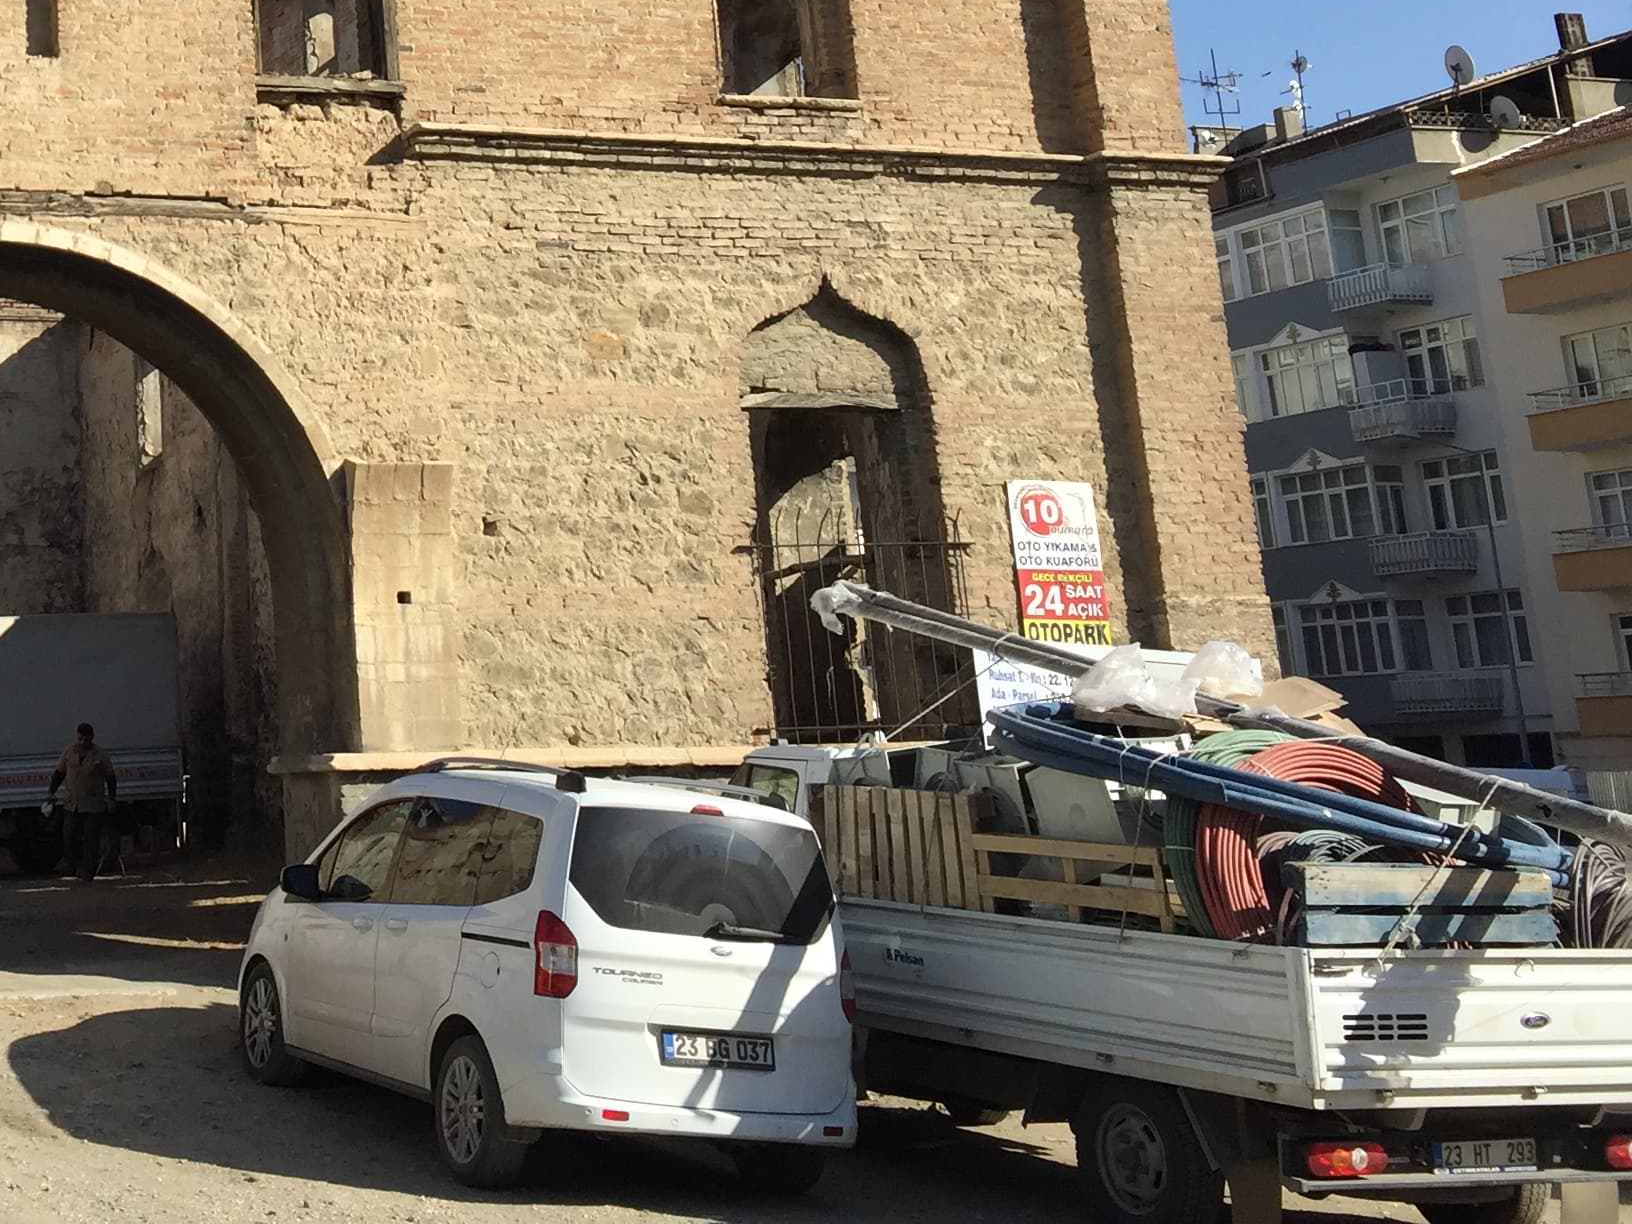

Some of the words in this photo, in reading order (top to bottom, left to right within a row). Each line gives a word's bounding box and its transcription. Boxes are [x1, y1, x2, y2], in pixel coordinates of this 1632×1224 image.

[1024, 499, 1059, 524] 10
[1017, 541, 1041, 552] OTO
[1044, 542, 1087, 553] YIKAMA
[1019, 556, 1043, 566] OTO
[1046, 555, 1099, 567] KUAFÖRÜ
[1024, 584, 1064, 616] 24
[1065, 584, 1103, 599] SAAT
[1068, 603, 1104, 619] AÇIK
[1029, 622, 1110, 645] OTOPARK
[593, 967, 663, 980] TOURNEO
[675, 1035, 698, 1056] 23
[706, 1038, 730, 1060] BG
[736, 1040, 770, 1063] 037
[1444, 1145, 1463, 1166] 23
[1474, 1143, 1491, 1165] HT
[1507, 1141, 1534, 1163] 293
